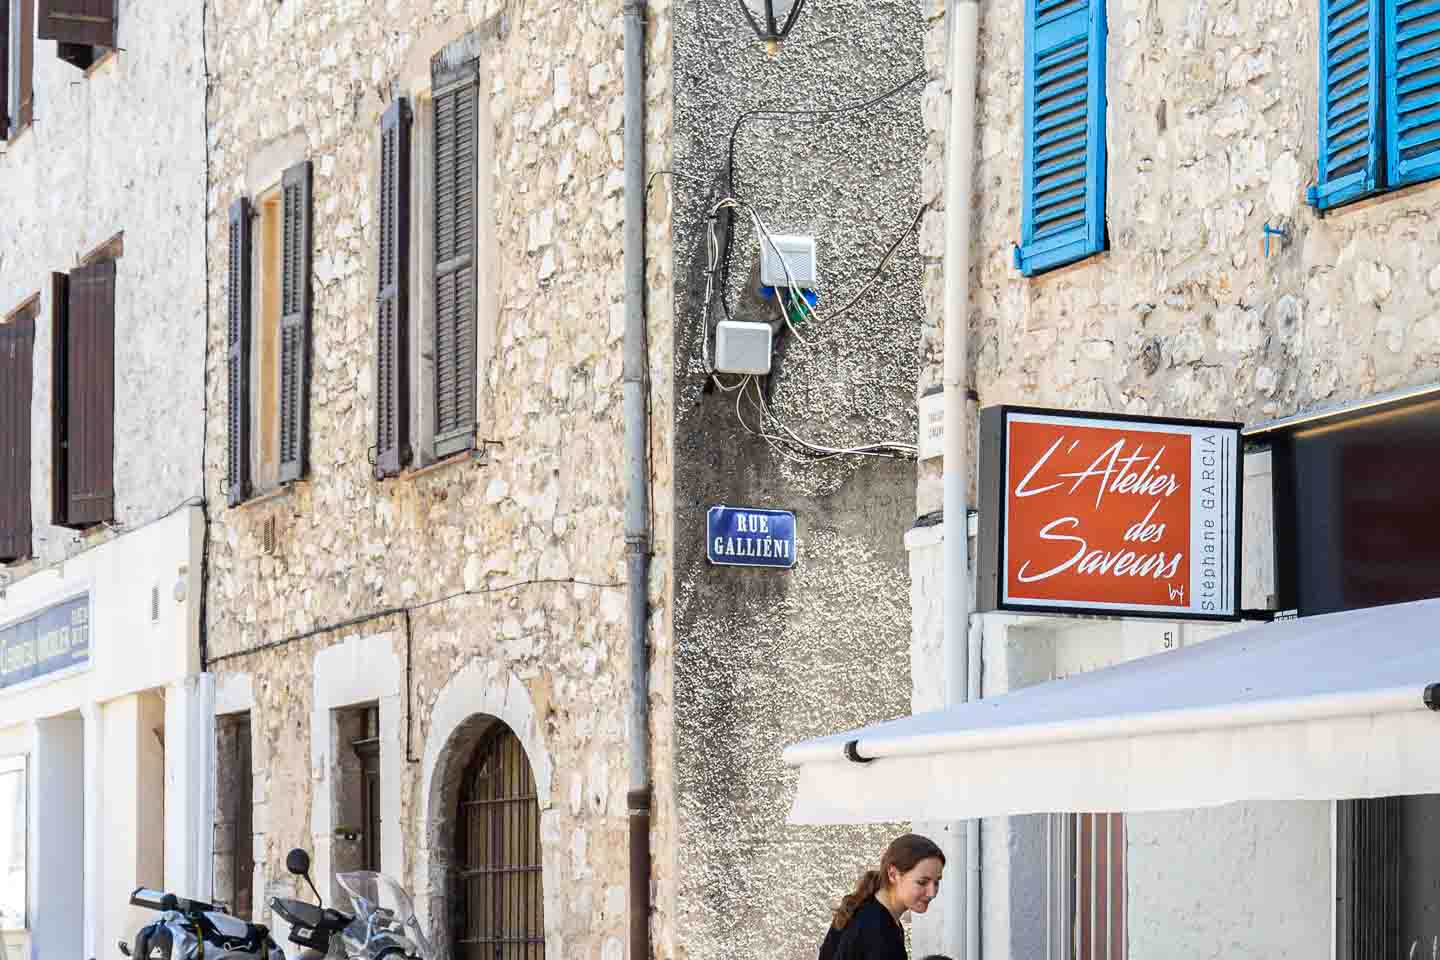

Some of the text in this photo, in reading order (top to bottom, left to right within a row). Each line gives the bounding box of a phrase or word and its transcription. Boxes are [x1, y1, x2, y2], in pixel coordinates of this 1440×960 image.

[1014, 434, 1184, 511] L'Atelier
[1201, 434, 1217, 510] GARCIA
[714, 535, 790, 559] GALLIÉNI
[737, 512, 769, 533] RUE
[1123, 499, 1166, 543] des
[1017, 516, 1184, 583] Saveurs
